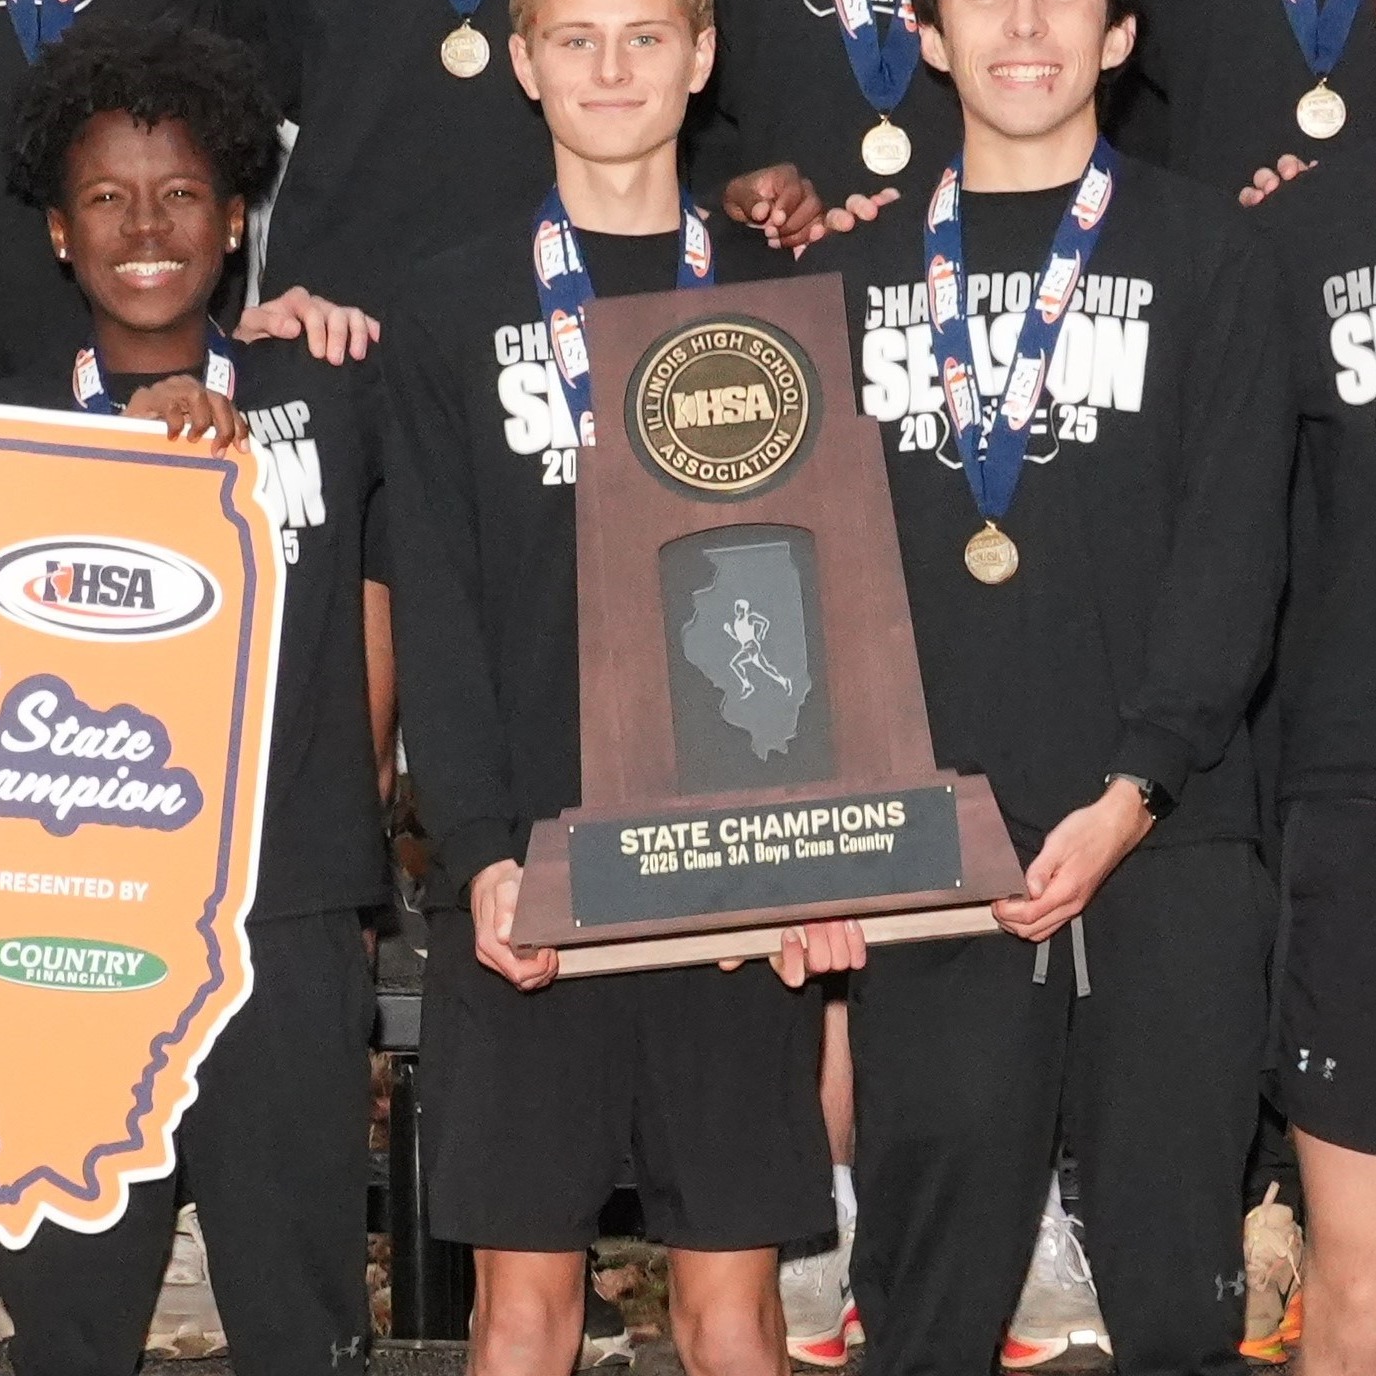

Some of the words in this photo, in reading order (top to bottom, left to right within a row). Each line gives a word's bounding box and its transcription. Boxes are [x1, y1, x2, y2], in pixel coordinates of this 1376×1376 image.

[646, 346, 688, 431] ILLINOIS
[690, 332, 744, 354] HIGH
[749, 339, 800, 416] SCHOOL
[672, 383, 775, 430] IHSA
[899, 413, 937, 452] 20
[1059, 405, 1098, 443] 25
[659, 428, 792, 481] ASSOCIATION
[42, 559, 156, 610] IHSA
[0, 689, 154, 762] State
[620, 821, 710, 855] STATE
[719, 801, 906, 843] CHAMPIONS
[684, 849, 723, 871] Class
[728, 845, 750, 865] 3A
[755, 841, 790, 866] Boys
[795, 838, 835, 859] Cross
[840, 831, 895, 854] Country
[118, 880, 150, 902] BY
[0, 941, 145, 977] COUNTRY
